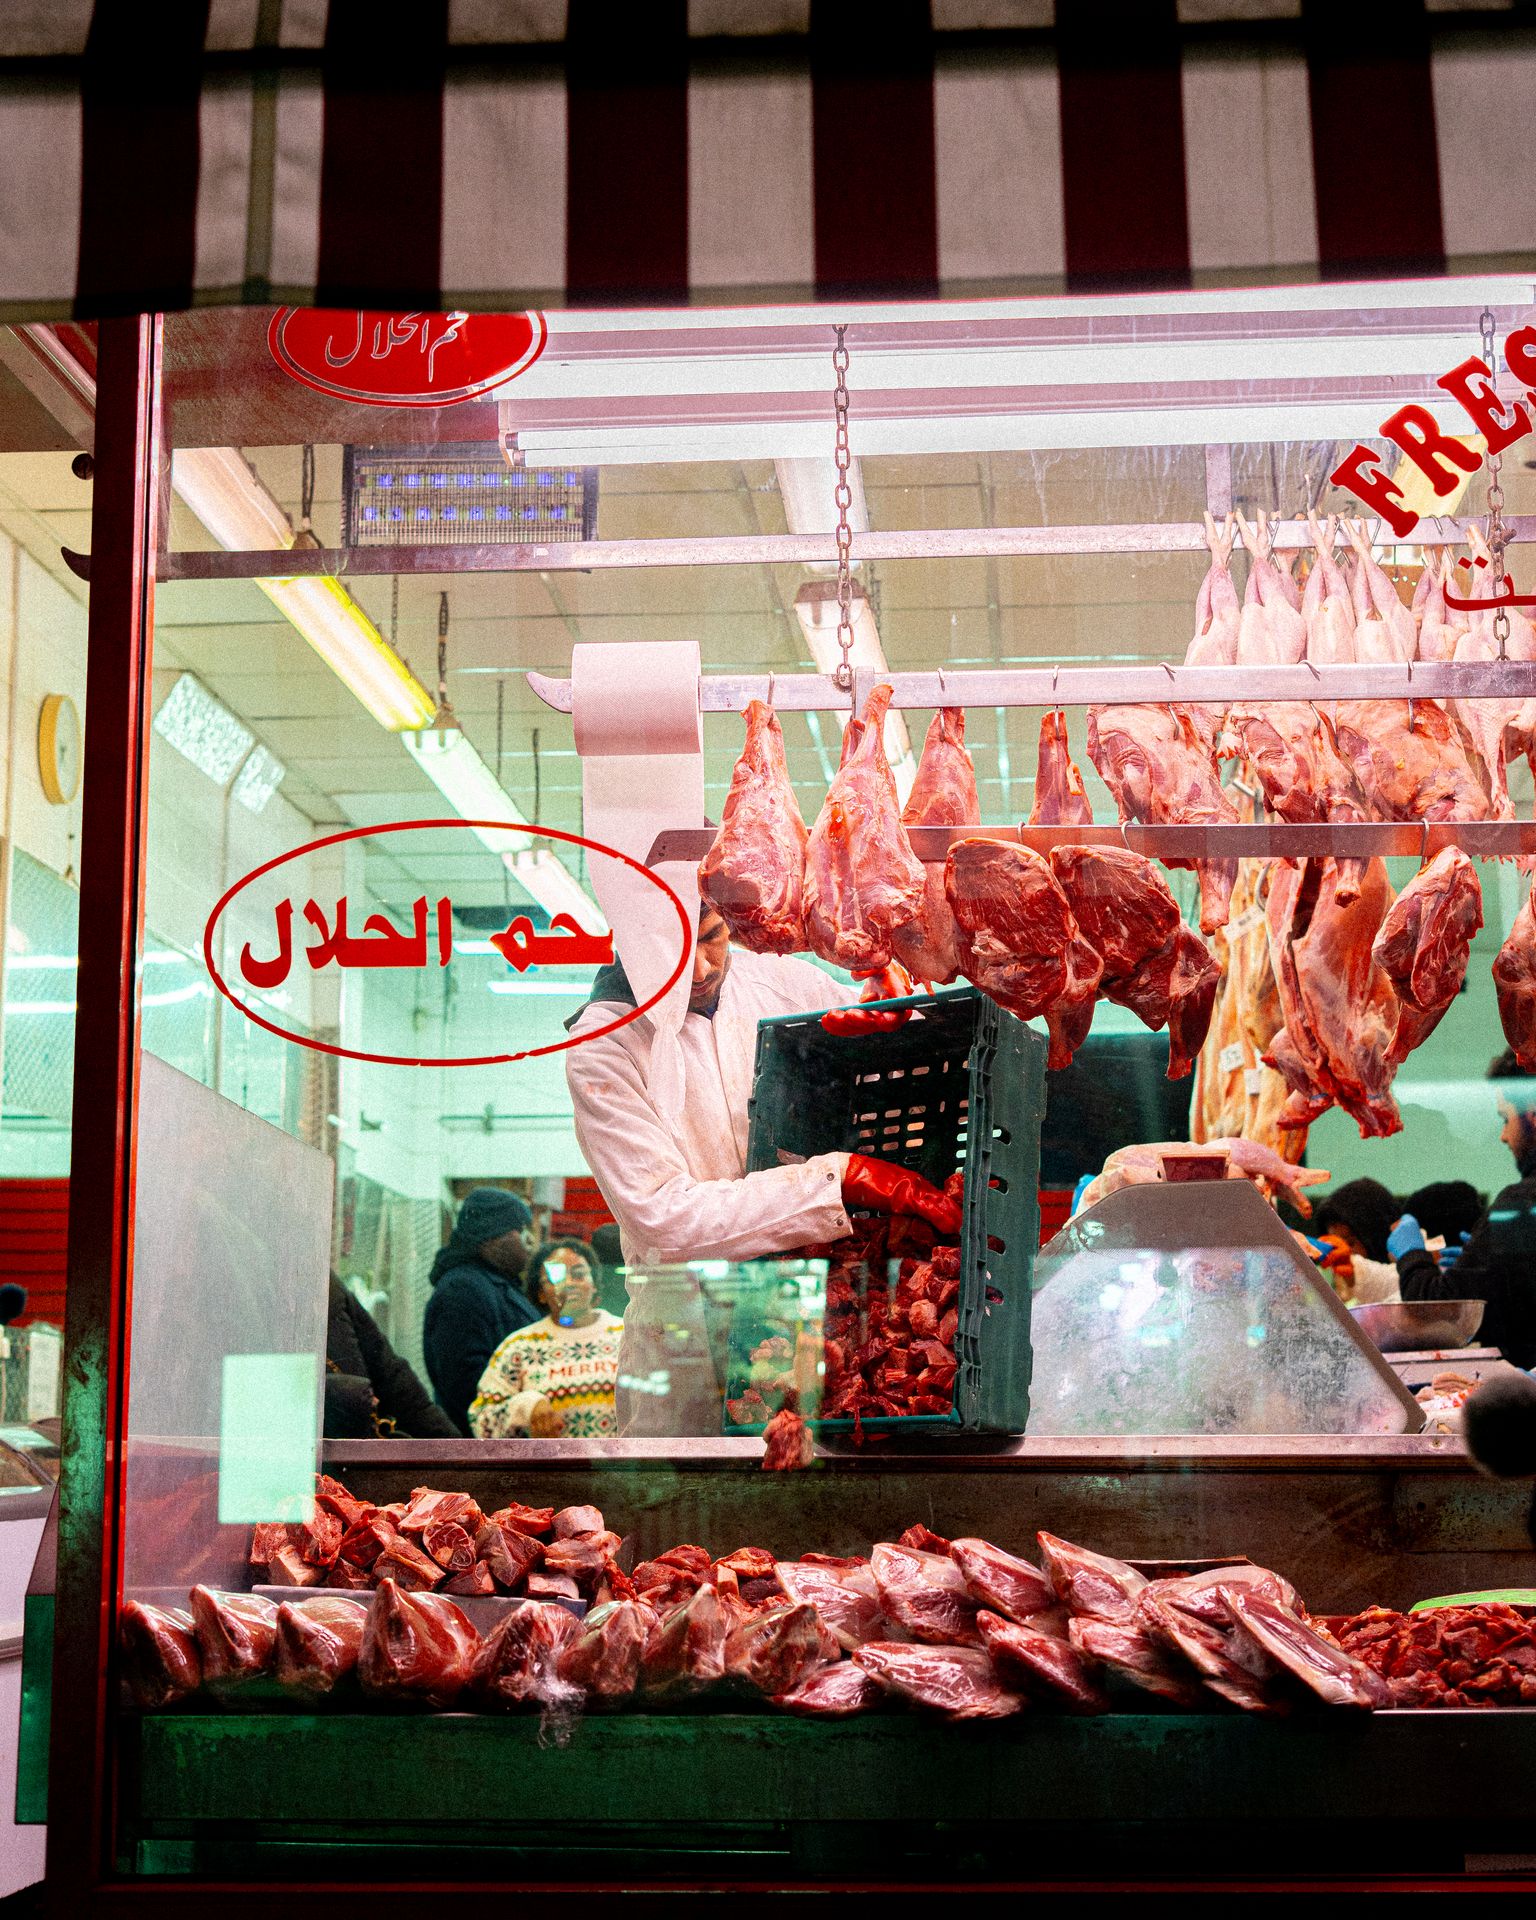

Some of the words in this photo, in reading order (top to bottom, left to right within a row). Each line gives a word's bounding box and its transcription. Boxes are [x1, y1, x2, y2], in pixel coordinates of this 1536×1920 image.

[428, 310, 470, 383] حم
[240, 896, 452, 988] الحلال
[549, 1361, 618, 1379] MERRY
